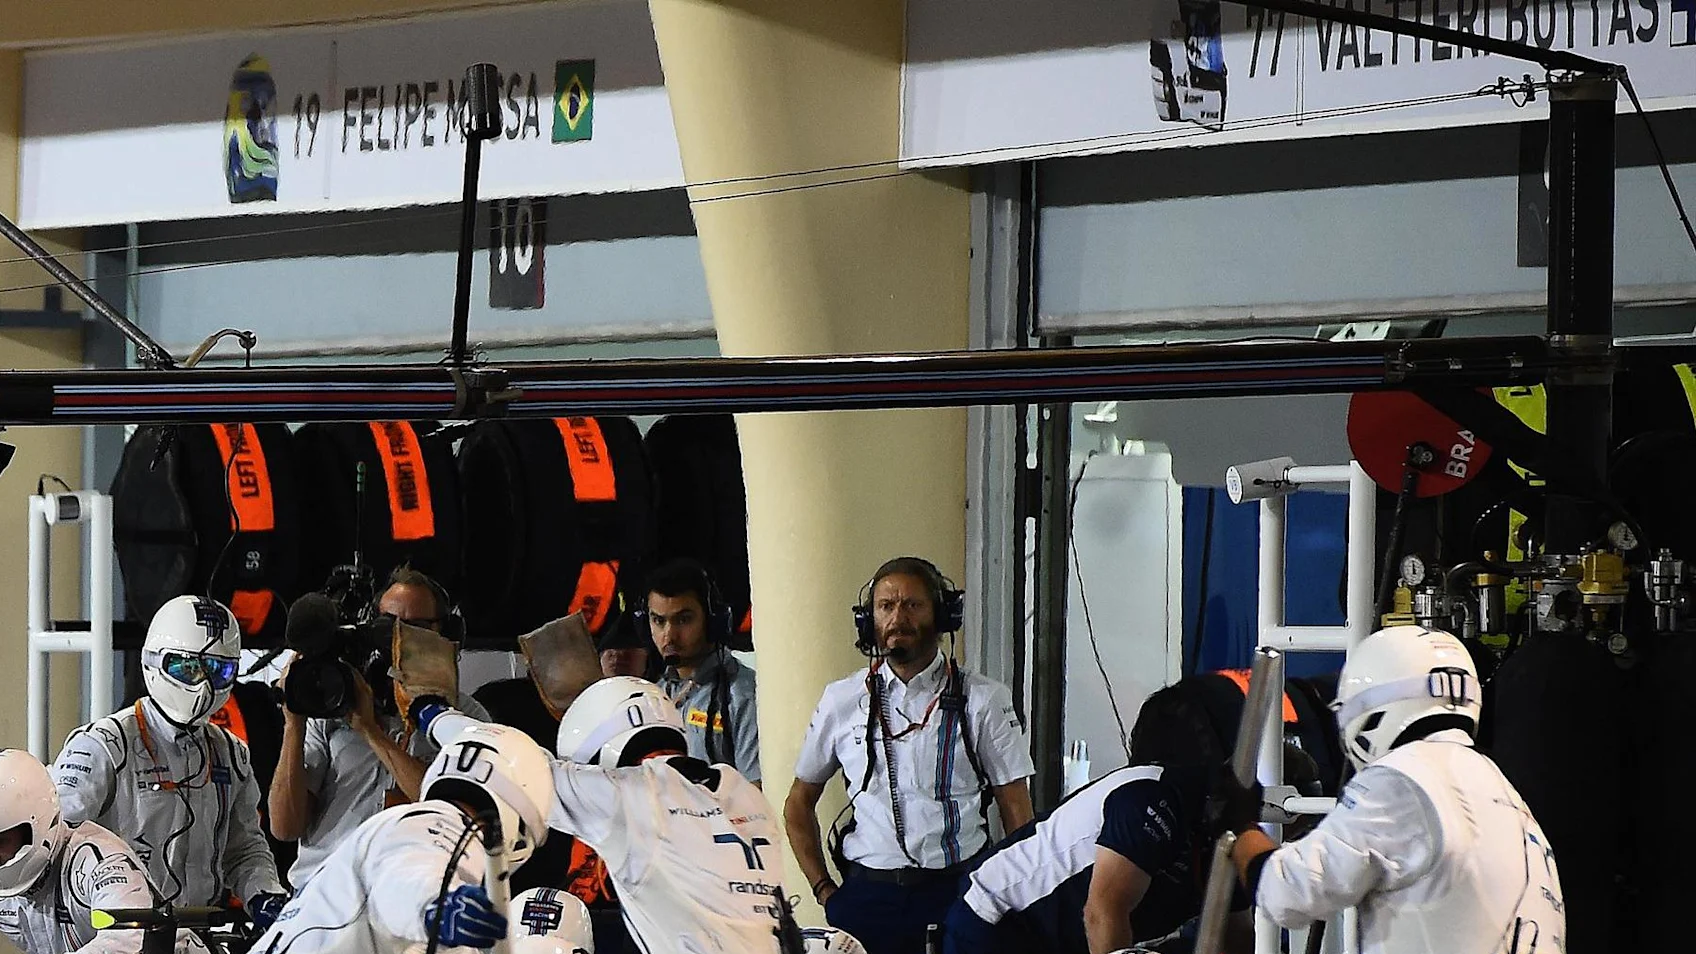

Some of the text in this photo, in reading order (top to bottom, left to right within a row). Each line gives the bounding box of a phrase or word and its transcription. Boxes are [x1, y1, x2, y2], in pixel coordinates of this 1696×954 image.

[1246, 0, 1289, 78] 77
[1506, 0, 1660, 54] BOTTAS
[293, 70, 541, 158] 19 FELIPE MSA
[235, 459, 261, 498] LEFT
[668, 807, 723, 819] WILLIAMS
[729, 878, 778, 898] rands
